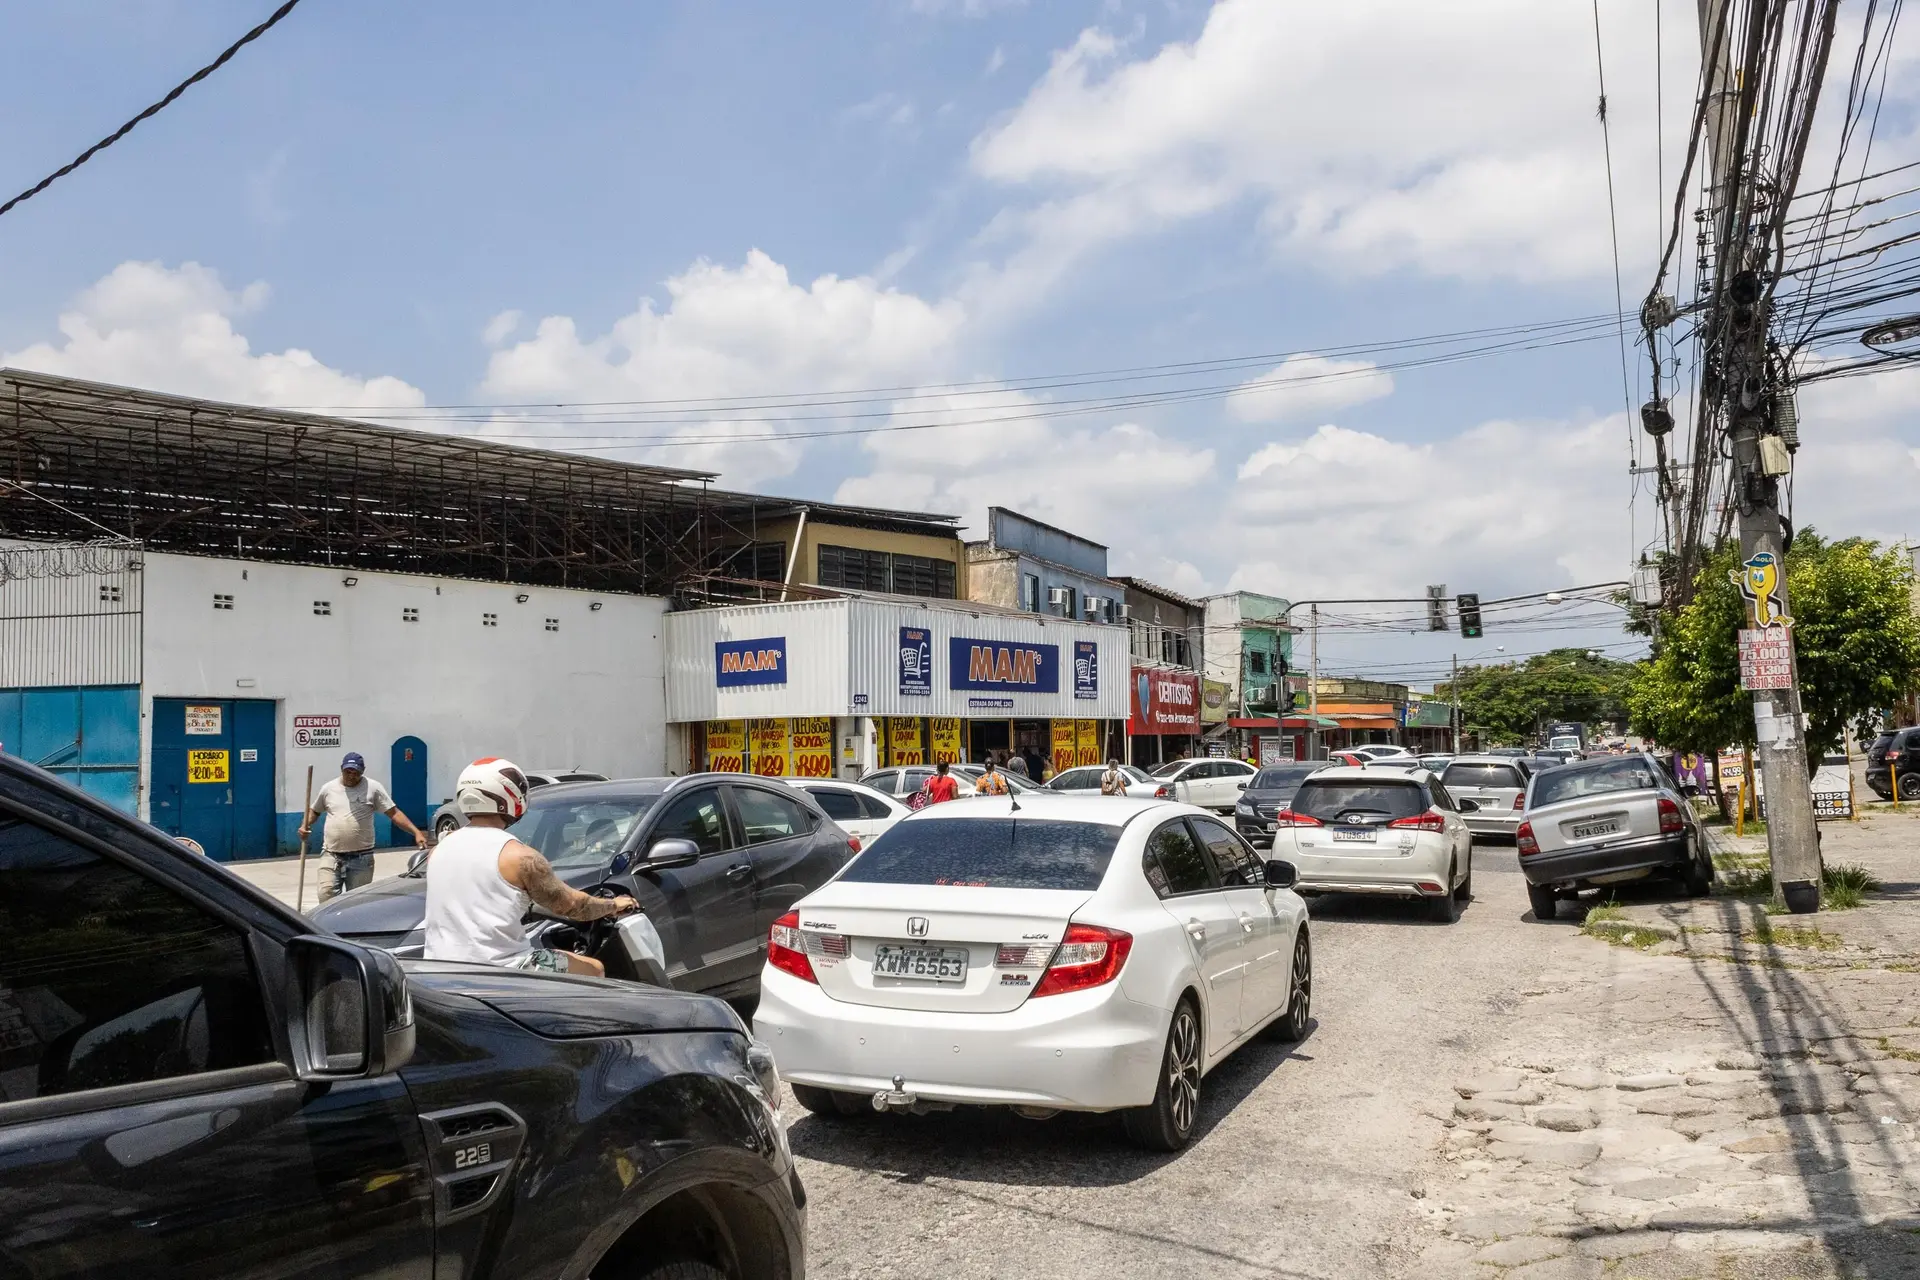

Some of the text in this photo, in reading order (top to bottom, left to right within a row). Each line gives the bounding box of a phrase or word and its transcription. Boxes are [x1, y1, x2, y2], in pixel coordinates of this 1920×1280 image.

[1741, 628, 1787, 643] VENDO CASA
[1741, 648, 1789, 660] 75.000
[1741, 666, 1757, 676] R$
[1746, 675, 1791, 689] 96910-3669
[1158, 681, 1193, 705] DENTISTAS
[296, 717, 339, 727] ATENÇÃO
[310, 738, 339, 746] DESCARGA
[793, 735, 823, 748] SOYA
[193, 750, 224, 760] HORÁRIO
